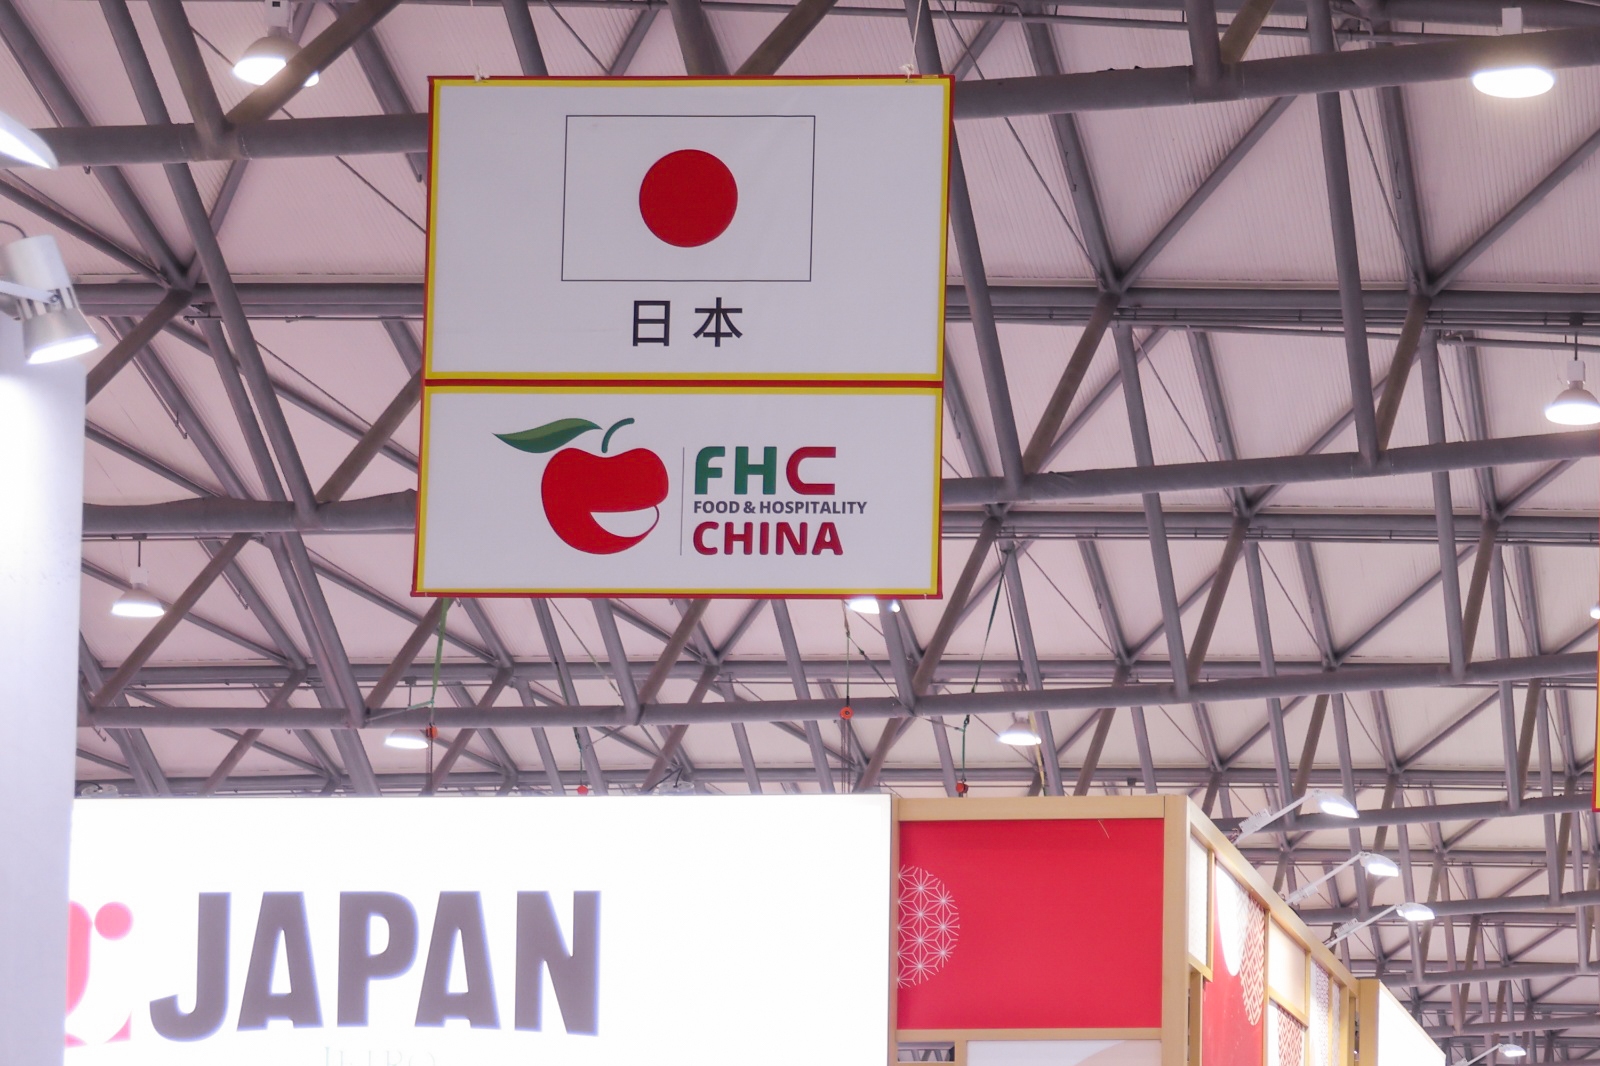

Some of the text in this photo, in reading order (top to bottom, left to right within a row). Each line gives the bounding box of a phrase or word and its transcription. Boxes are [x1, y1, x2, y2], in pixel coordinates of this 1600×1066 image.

[632, 296, 744, 347] 日本
[694, 446, 836, 495] FHC
[693, 502, 868, 515] FOOD & HOSPITALITY
[692, 521, 844, 556] CHINA
[150, 890, 602, 1042] JAPAN
